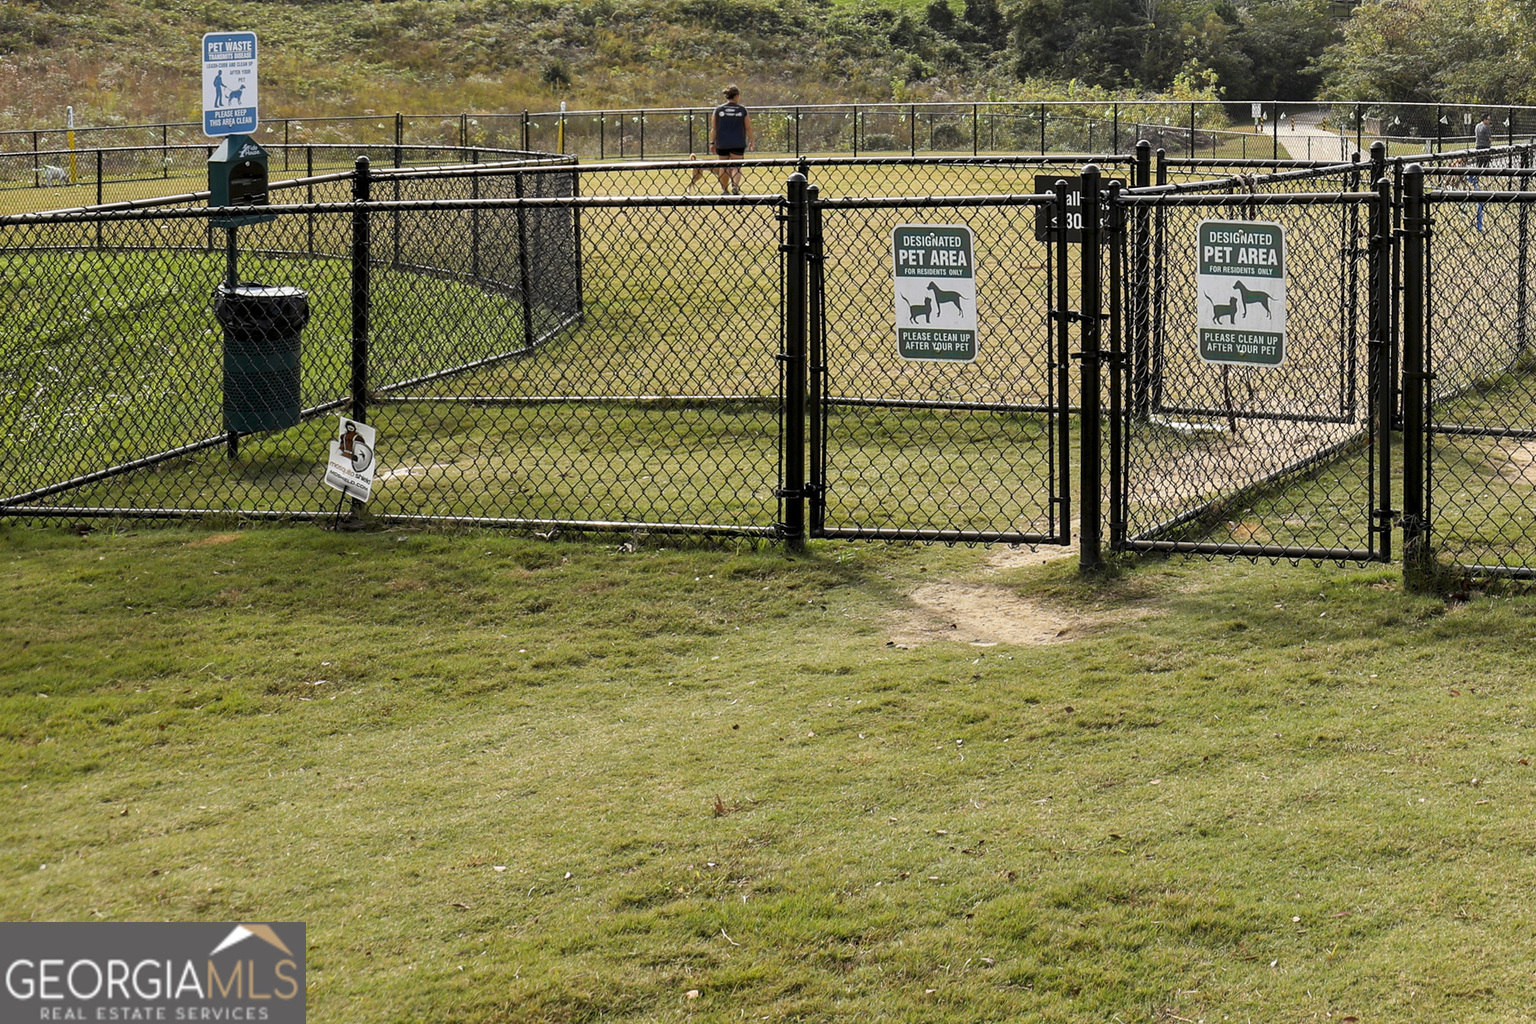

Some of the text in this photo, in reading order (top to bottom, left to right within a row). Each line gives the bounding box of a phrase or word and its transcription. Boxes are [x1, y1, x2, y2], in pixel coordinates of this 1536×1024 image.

[208, 41, 252, 52] PET WASTE
[215, 110, 234, 118] PLEASE
[222, 118, 235, 126] AREA
[236, 116, 252, 124] CLEAN
[1066, 213, 1082, 230] 30
[903, 236, 962, 248] DESIGNATED
[1210, 232, 1272, 245] DESIGNATED
[899, 250, 968, 266] PET AREA
[1204, 246, 1278, 266] PET AREA
[917, 268, 946, 276] RESIDENTS
[948, 268, 963, 276] ONLY
[1223, 266, 1256, 274] RESIDENTS
[902, 332, 970, 342] PLEASE CLEAN UP
[1204, 332, 1278, 345] PLEASE CLEAN UP
[905, 342, 970, 352] AFTER YOUR PET
[1207, 342, 1276, 356] AFTER YOUR PET
